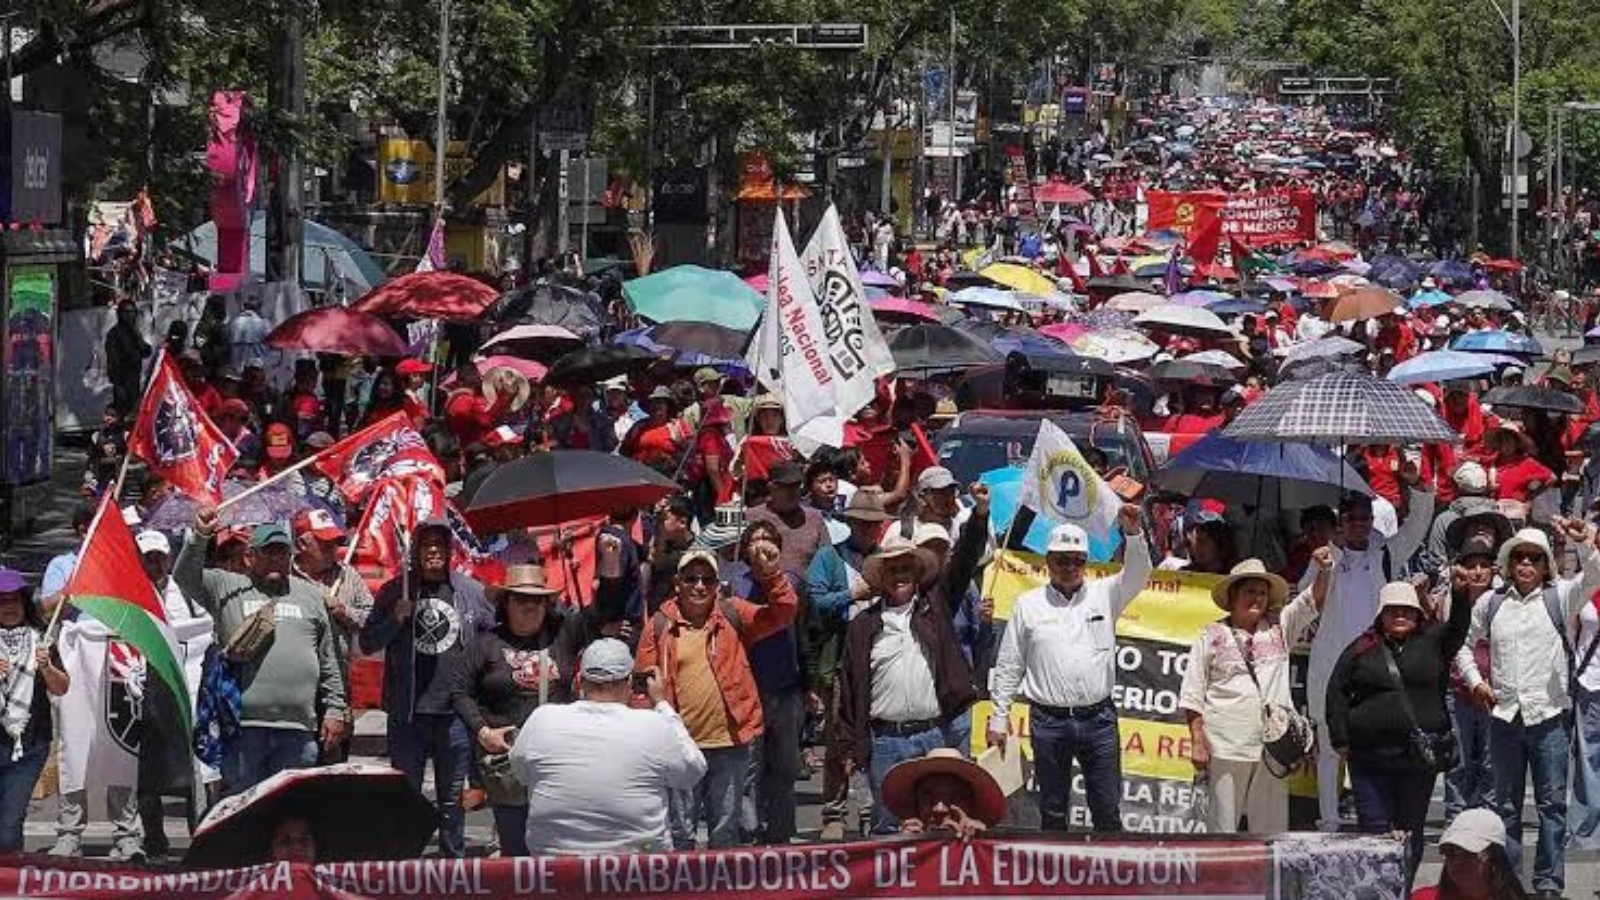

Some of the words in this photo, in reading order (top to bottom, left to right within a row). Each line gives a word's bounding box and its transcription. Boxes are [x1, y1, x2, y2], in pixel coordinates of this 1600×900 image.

[1221, 220, 1240, 233] DE
[787, 306, 833, 386] Nacional
[1111, 683, 1178, 714] ERIO
[1158, 734, 1192, 758] RE
[316, 856, 491, 894] NACIONAL
[514, 855, 557, 894] DE
[581, 849, 852, 893] TRABAJADORES
[873, 847, 916, 888] DE
[939, 846, 980, 888] LA
